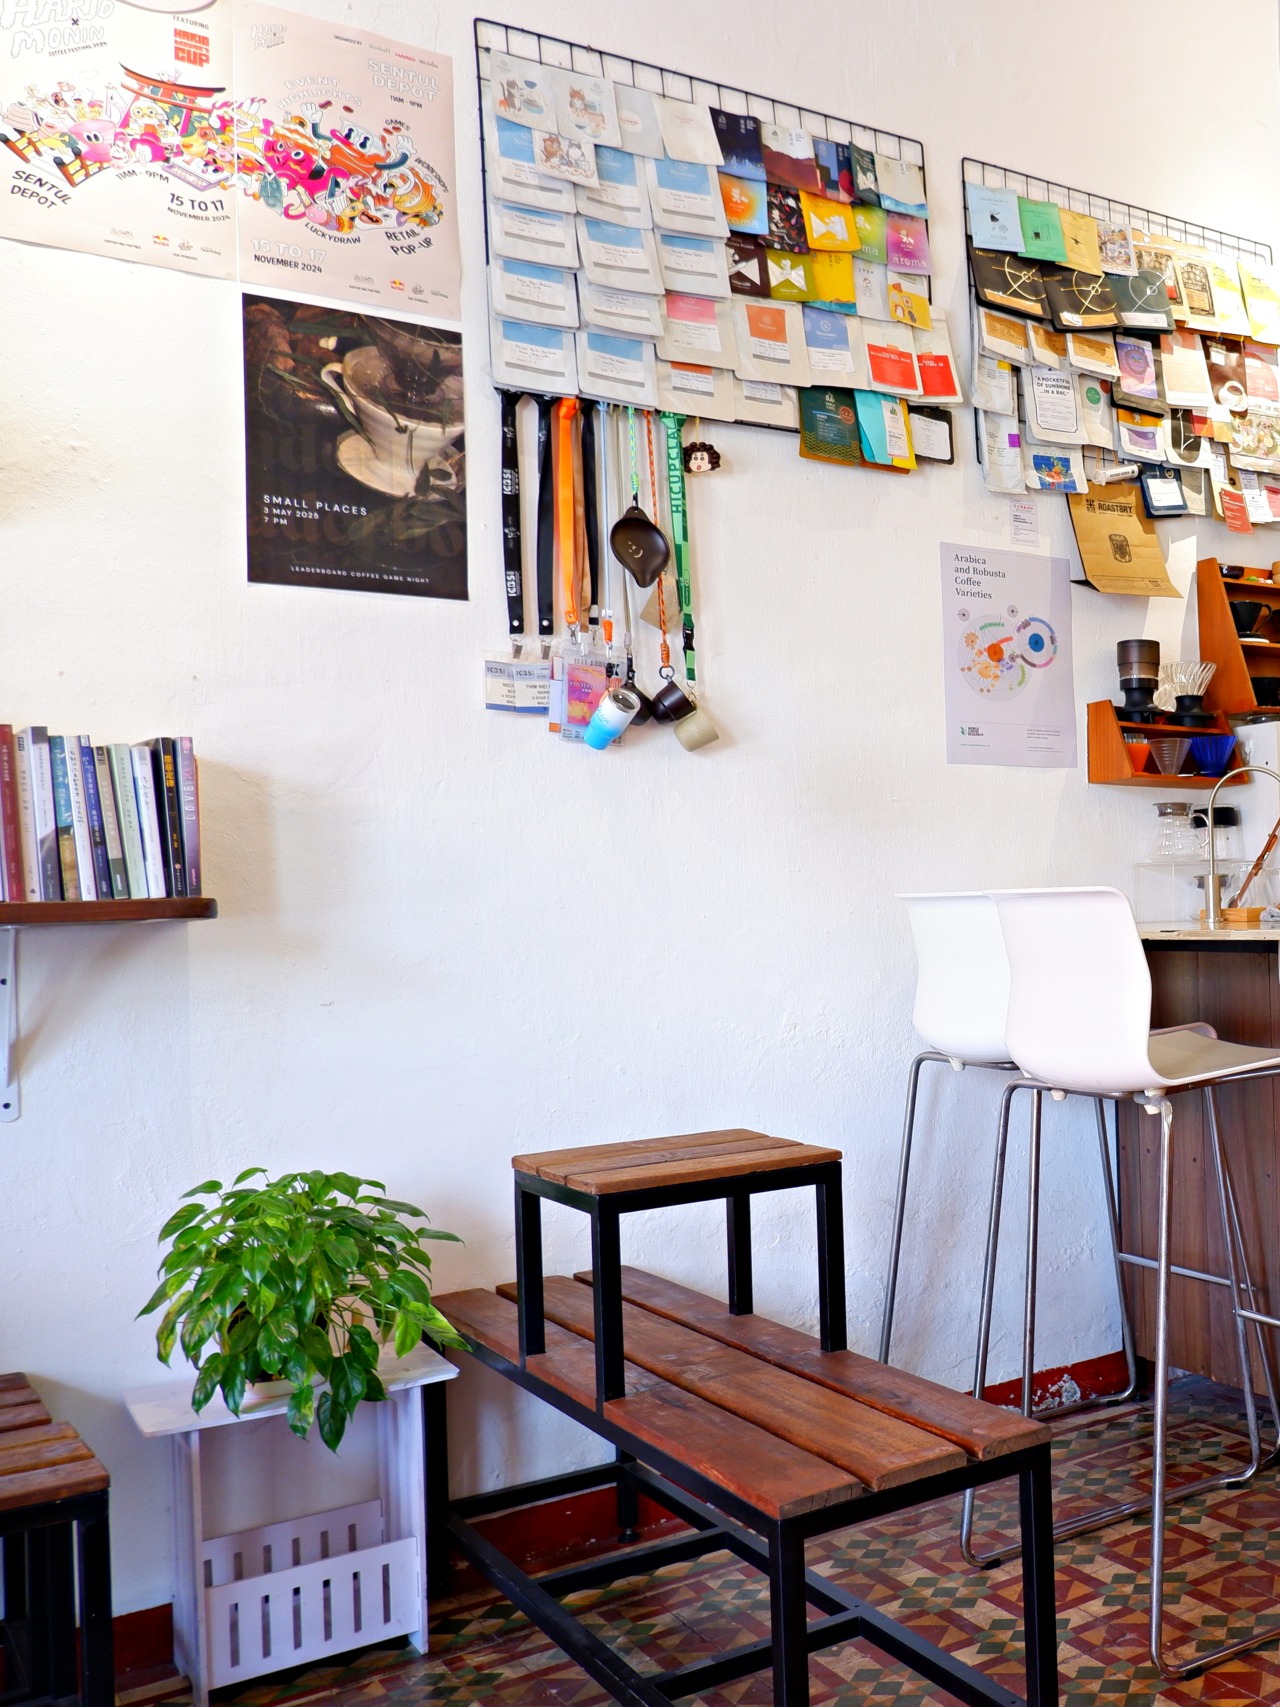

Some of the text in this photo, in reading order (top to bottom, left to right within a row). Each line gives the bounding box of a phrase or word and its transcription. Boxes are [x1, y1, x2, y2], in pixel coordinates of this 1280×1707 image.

[172, 15, 210, 30] FEATURING
[11, 26, 105, 59] MONIN
[174, 46, 210, 68] CUP
[284, 76, 340, 90] EVENT
[368, 59, 441, 91] SENTUL
[373, 75, 437, 102] DEPOT
[276, 88, 362, 111] HIGHLIGHTS
[385, 118, 411, 132] GAMES
[145, 170, 170, 184] 9PM
[12, 170, 72, 206] SENTUL
[10, 185, 57, 210] DEPOT
[169, 192, 225, 212] 15 TO 17
[167, 207, 210, 223] NOVEMBER
[304, 222, 361, 244] LUCKYDRAW
[385, 228, 420, 241] RETAIL
[251, 237, 327, 264] 15 TO 17
[390, 237, 433, 256] POP-UP
[254, 254, 323, 274] NOVEMBER 2024
[1041, 376, 1071, 385] POCKETFUL
[1044, 383, 1071, 391] SUNSHINE
[263, 494, 368, 516] SMALL PLACES
[1098, 502, 1133, 514] ROAST8RY
[273, 508, 292, 517] MAY
[296, 511, 320, 520] 2025
[274, 517, 288, 526] PM
[953, 553, 987, 565] Arabica
[291, 566, 430, 584] LEADERBOARD COFFEE GAME NIGHT
[953, 565, 1006, 579] and Robusta
[954, 576, 982, 587] Coffee
[955, 587, 993, 600] Varieties
